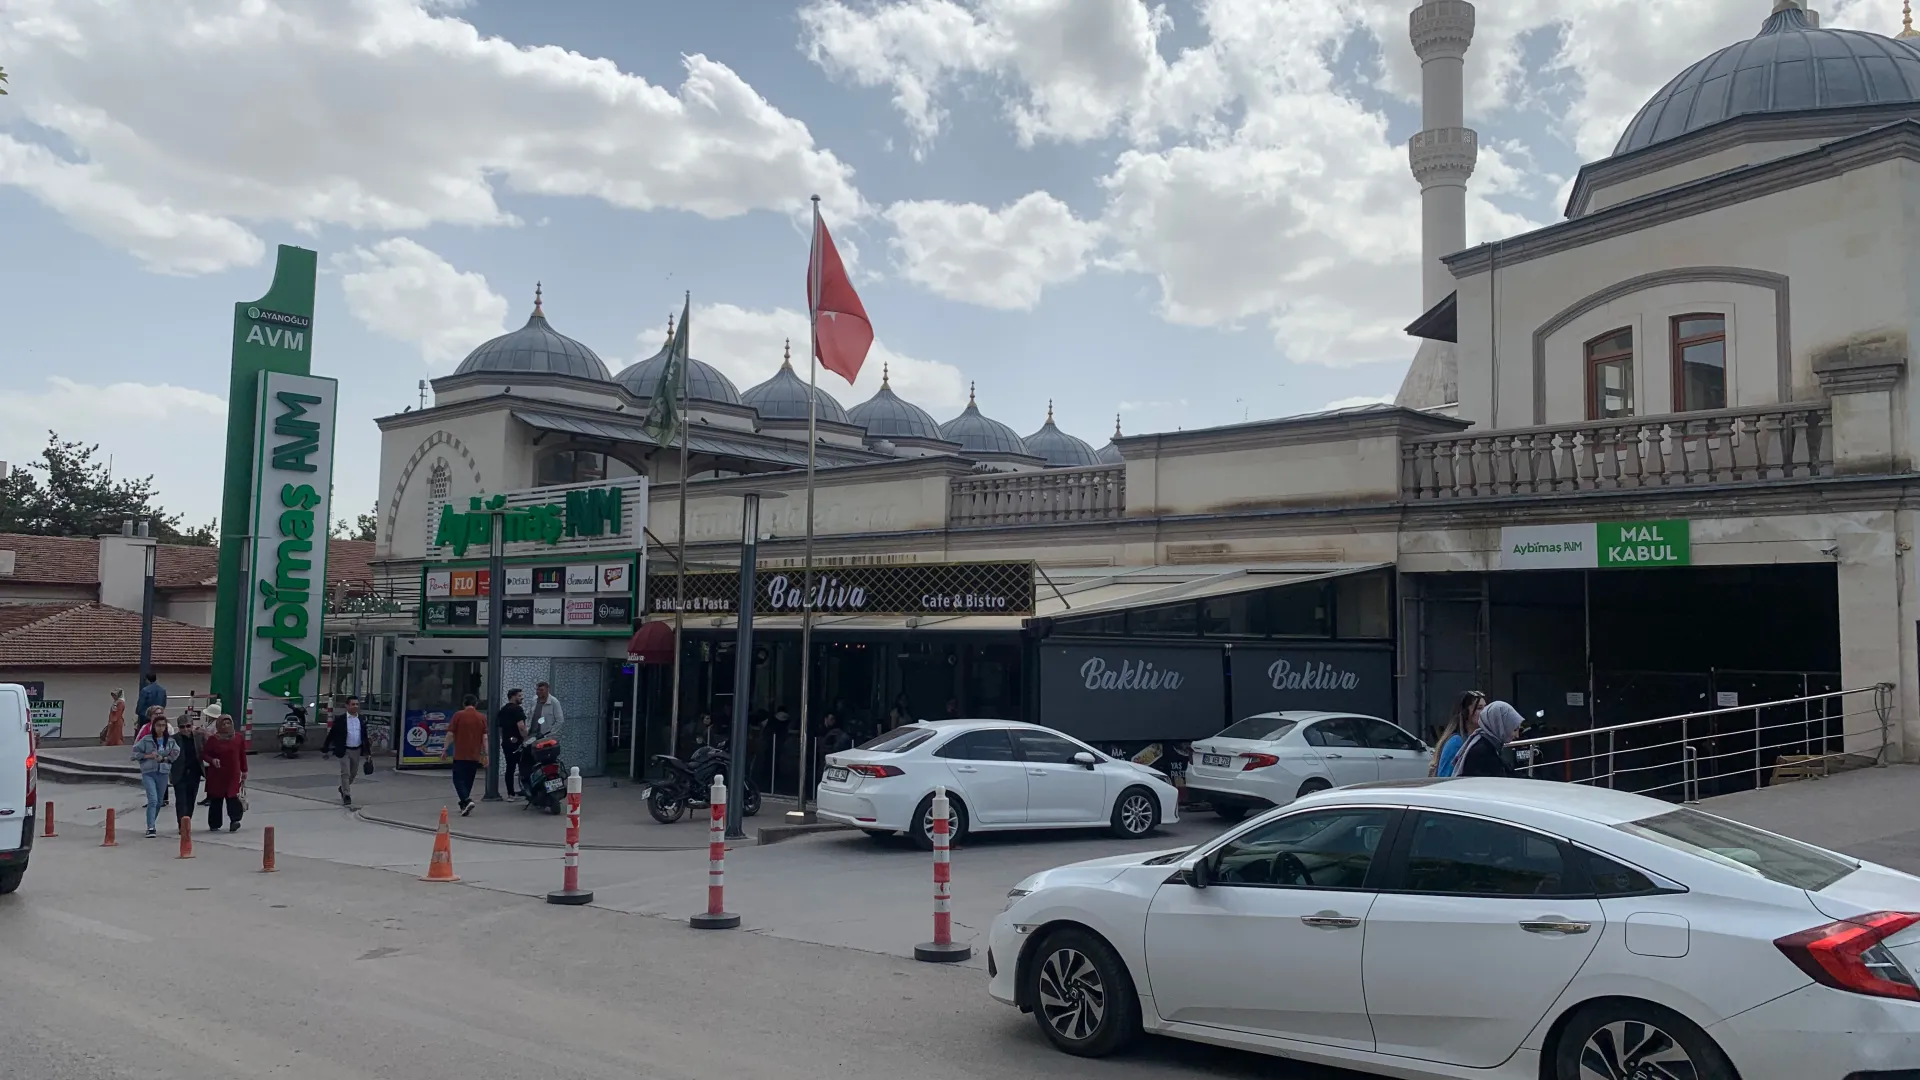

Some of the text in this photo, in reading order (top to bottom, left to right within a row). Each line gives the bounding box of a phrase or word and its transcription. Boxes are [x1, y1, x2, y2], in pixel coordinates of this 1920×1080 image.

[260, 311, 309, 326] AYANOĞLU
[246, 324, 304, 352] AVM
[1620, 525, 1664, 542] MAL
[1608, 545, 1678, 562] KABUL
[453, 577, 474, 590] FLO
[694, 596, 701, 610] &
[702, 597, 730, 610] Pasta
[922, 593, 1006, 608] Cafe & Bistro
[1080, 656, 1185, 691] Bakliva
[1267, 658, 1360, 691] Bakliva
